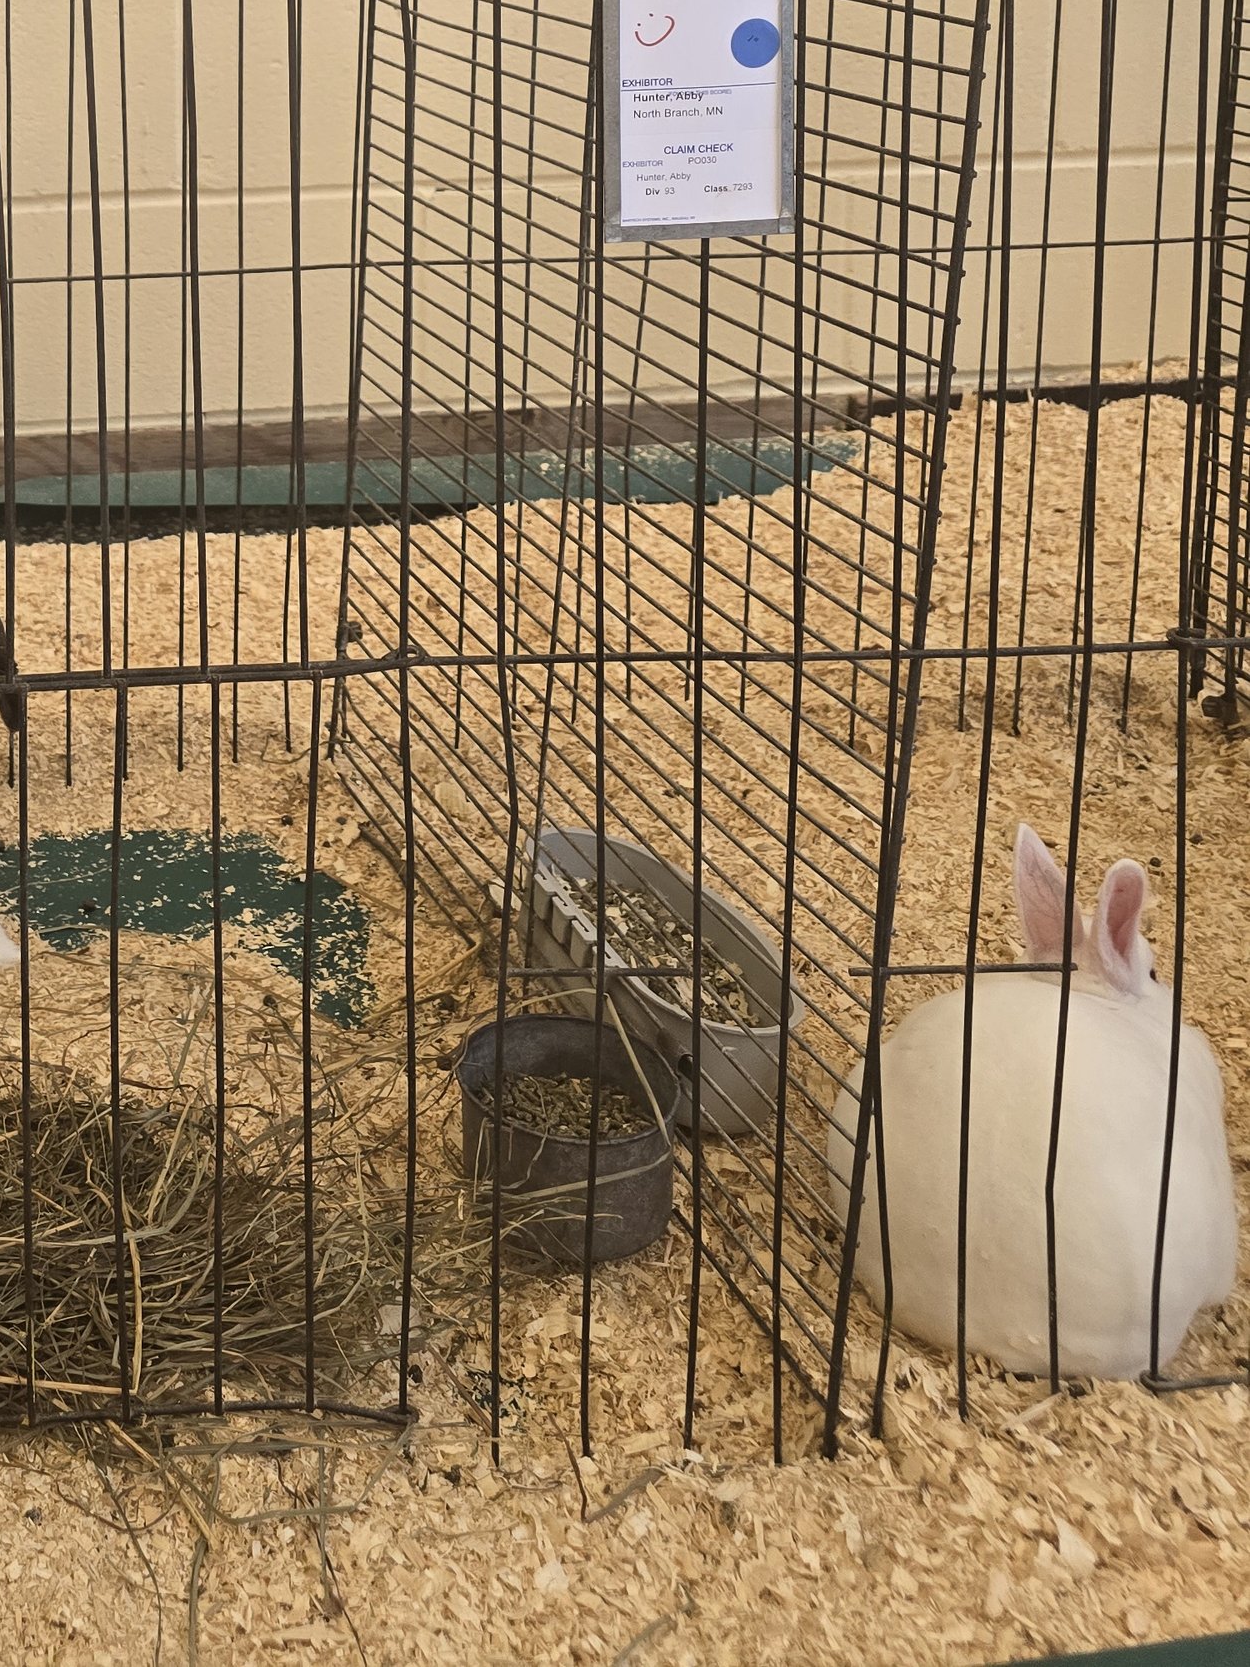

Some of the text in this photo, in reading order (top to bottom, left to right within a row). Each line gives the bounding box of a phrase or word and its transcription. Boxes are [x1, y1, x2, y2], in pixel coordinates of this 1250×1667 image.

[622, 78, 673, 87] EXHIBITOR
[633, 92, 673, 102] Hunter,
[676, 91, 704, 102] Abby
[633, 106, 723, 119] North Branch, MN
[664, 143, 734, 154] CLAIM CHECK
[622, 160, 663, 168] EXHIBITOR
[670, 172, 691, 182] Abby
[645, 188, 660, 196] Div
[665, 187, 675, 195] 93
[733, 183, 753, 191] 7293
